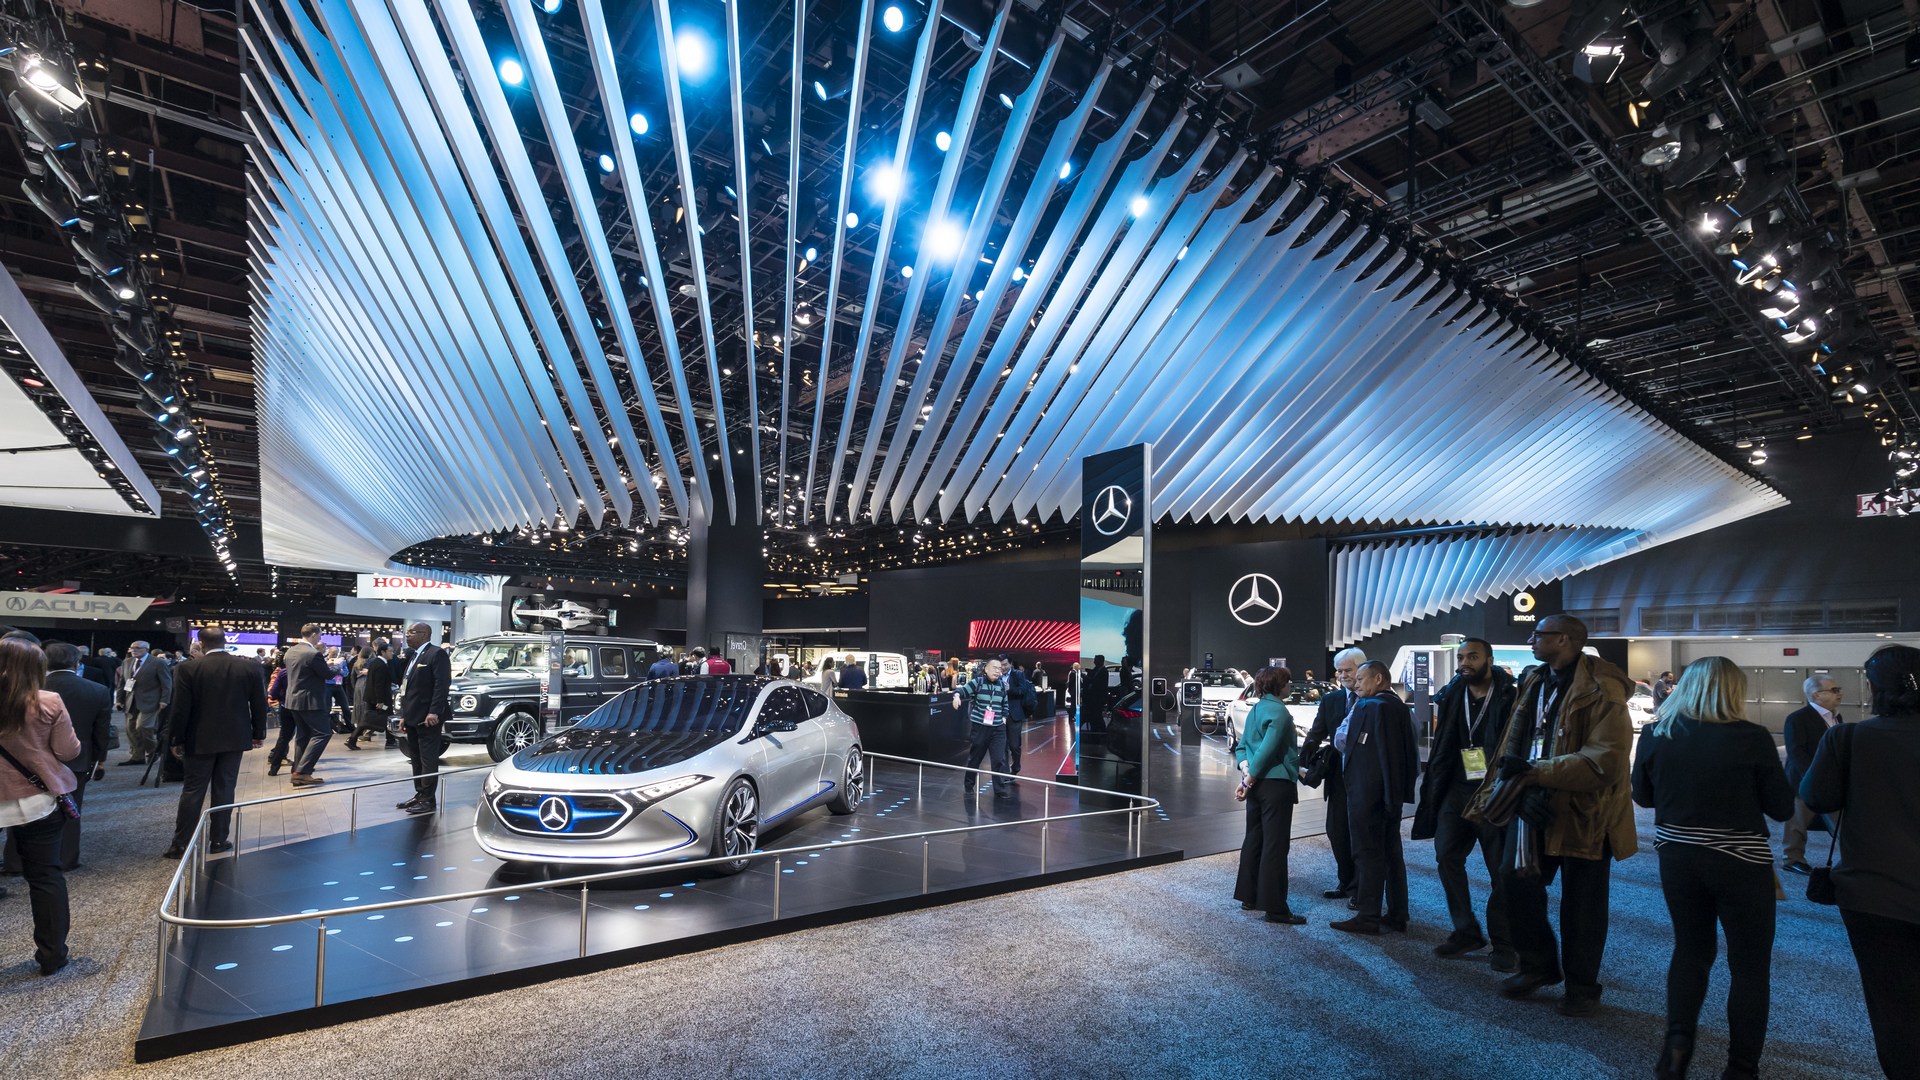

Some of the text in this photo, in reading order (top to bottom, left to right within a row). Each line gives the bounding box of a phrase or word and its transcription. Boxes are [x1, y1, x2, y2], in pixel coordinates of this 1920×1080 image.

[374, 577, 453, 588] HONDA
[28, 599, 131, 614] ACURA
[540, 681, 549, 704] World
